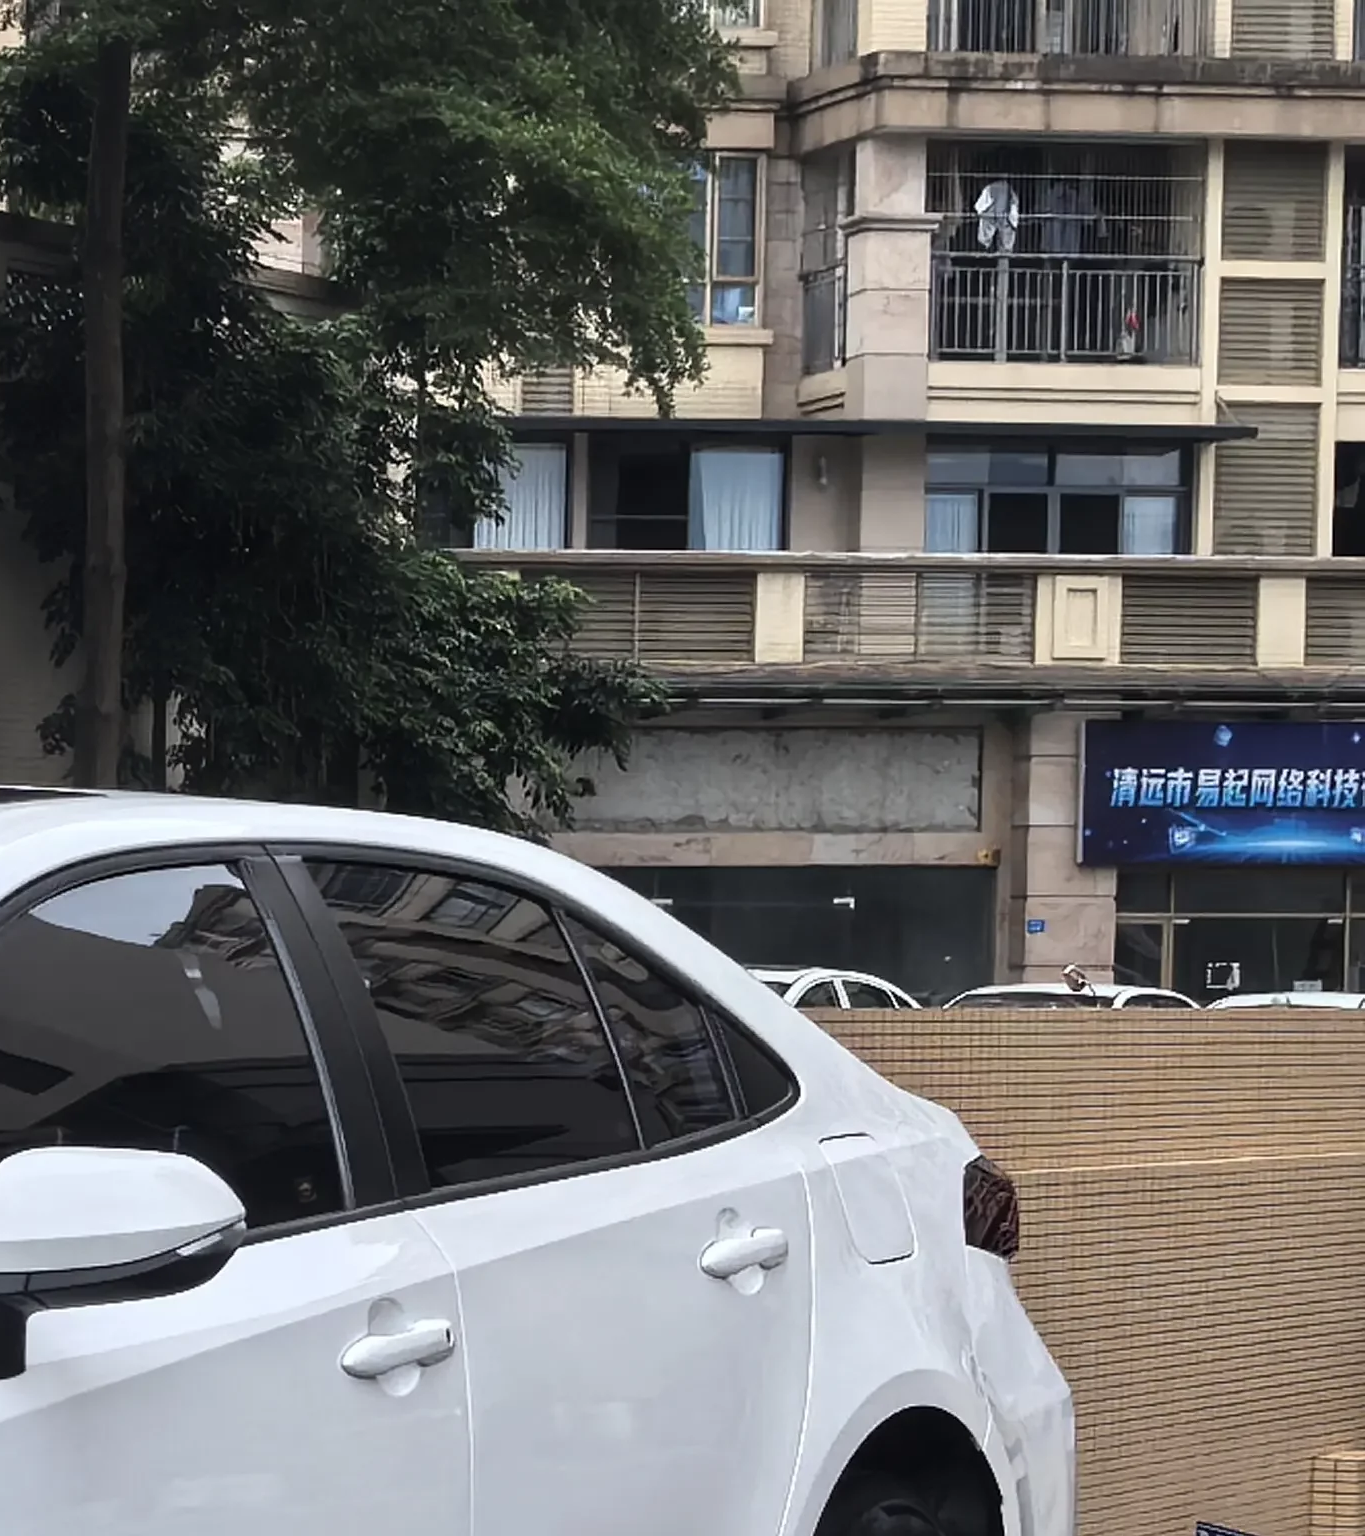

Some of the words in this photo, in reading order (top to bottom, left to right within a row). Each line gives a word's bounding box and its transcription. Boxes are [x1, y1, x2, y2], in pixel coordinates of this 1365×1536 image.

[1110, 767, 1365, 808] 清远市易起网络科技
